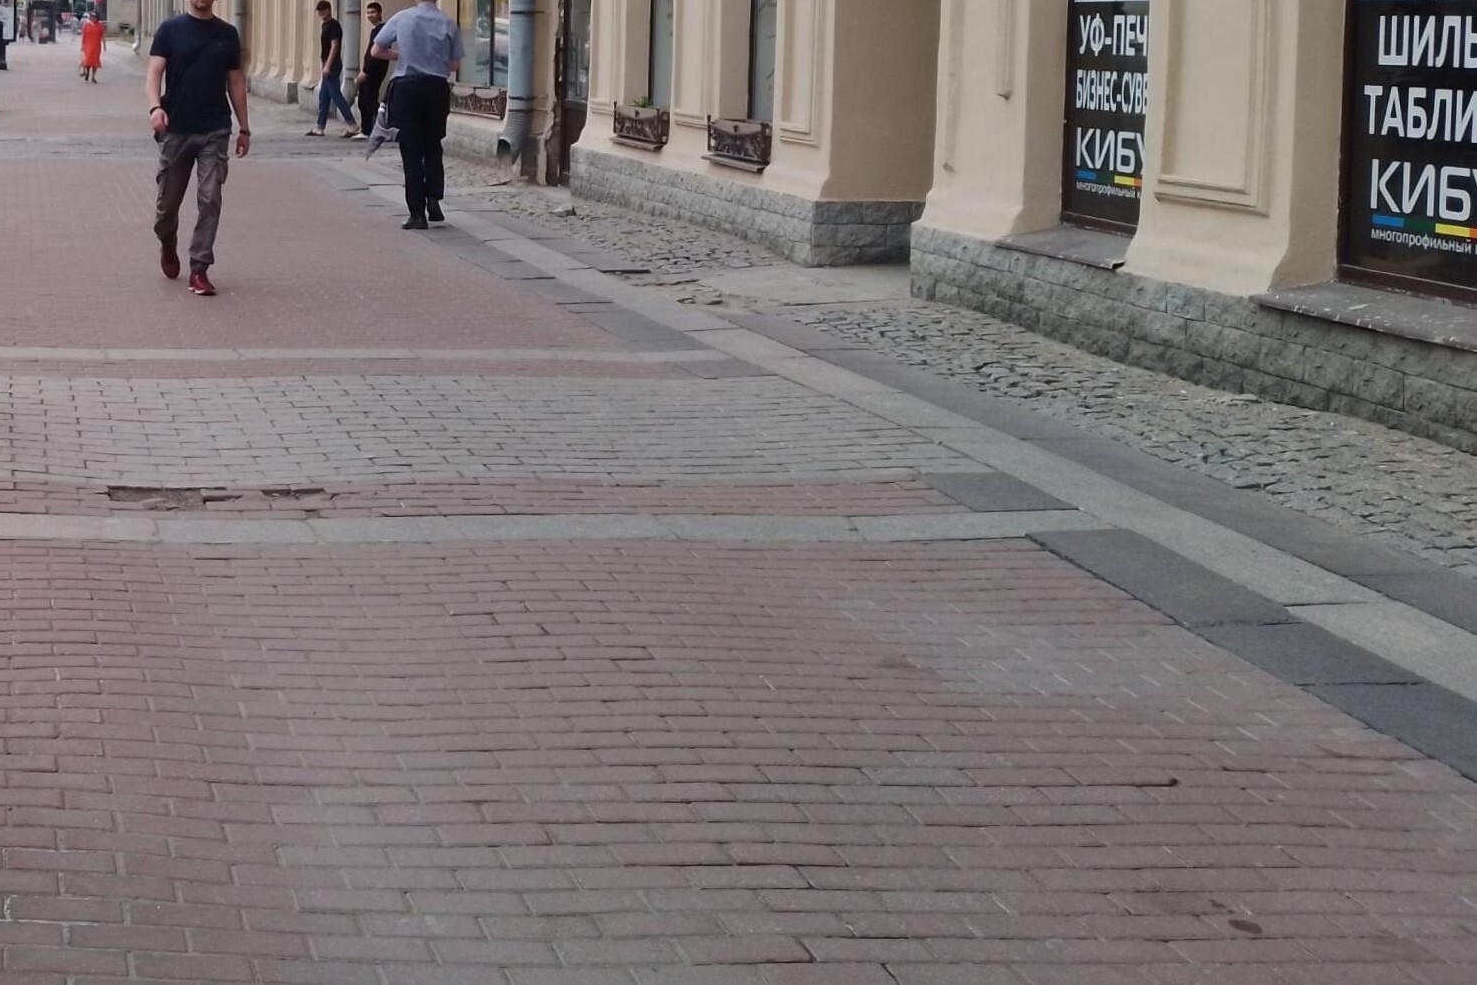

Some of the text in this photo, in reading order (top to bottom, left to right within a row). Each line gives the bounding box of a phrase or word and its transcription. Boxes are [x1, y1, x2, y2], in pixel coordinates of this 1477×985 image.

[1079, 13, 1148, 56] УФ-ПЕЧ
[1363, 84, 1477, 143] ТАБЛИ
[1370, 159, 1477, 221] КИБ
[1371, 228, 1472, 255] многопрофильный
